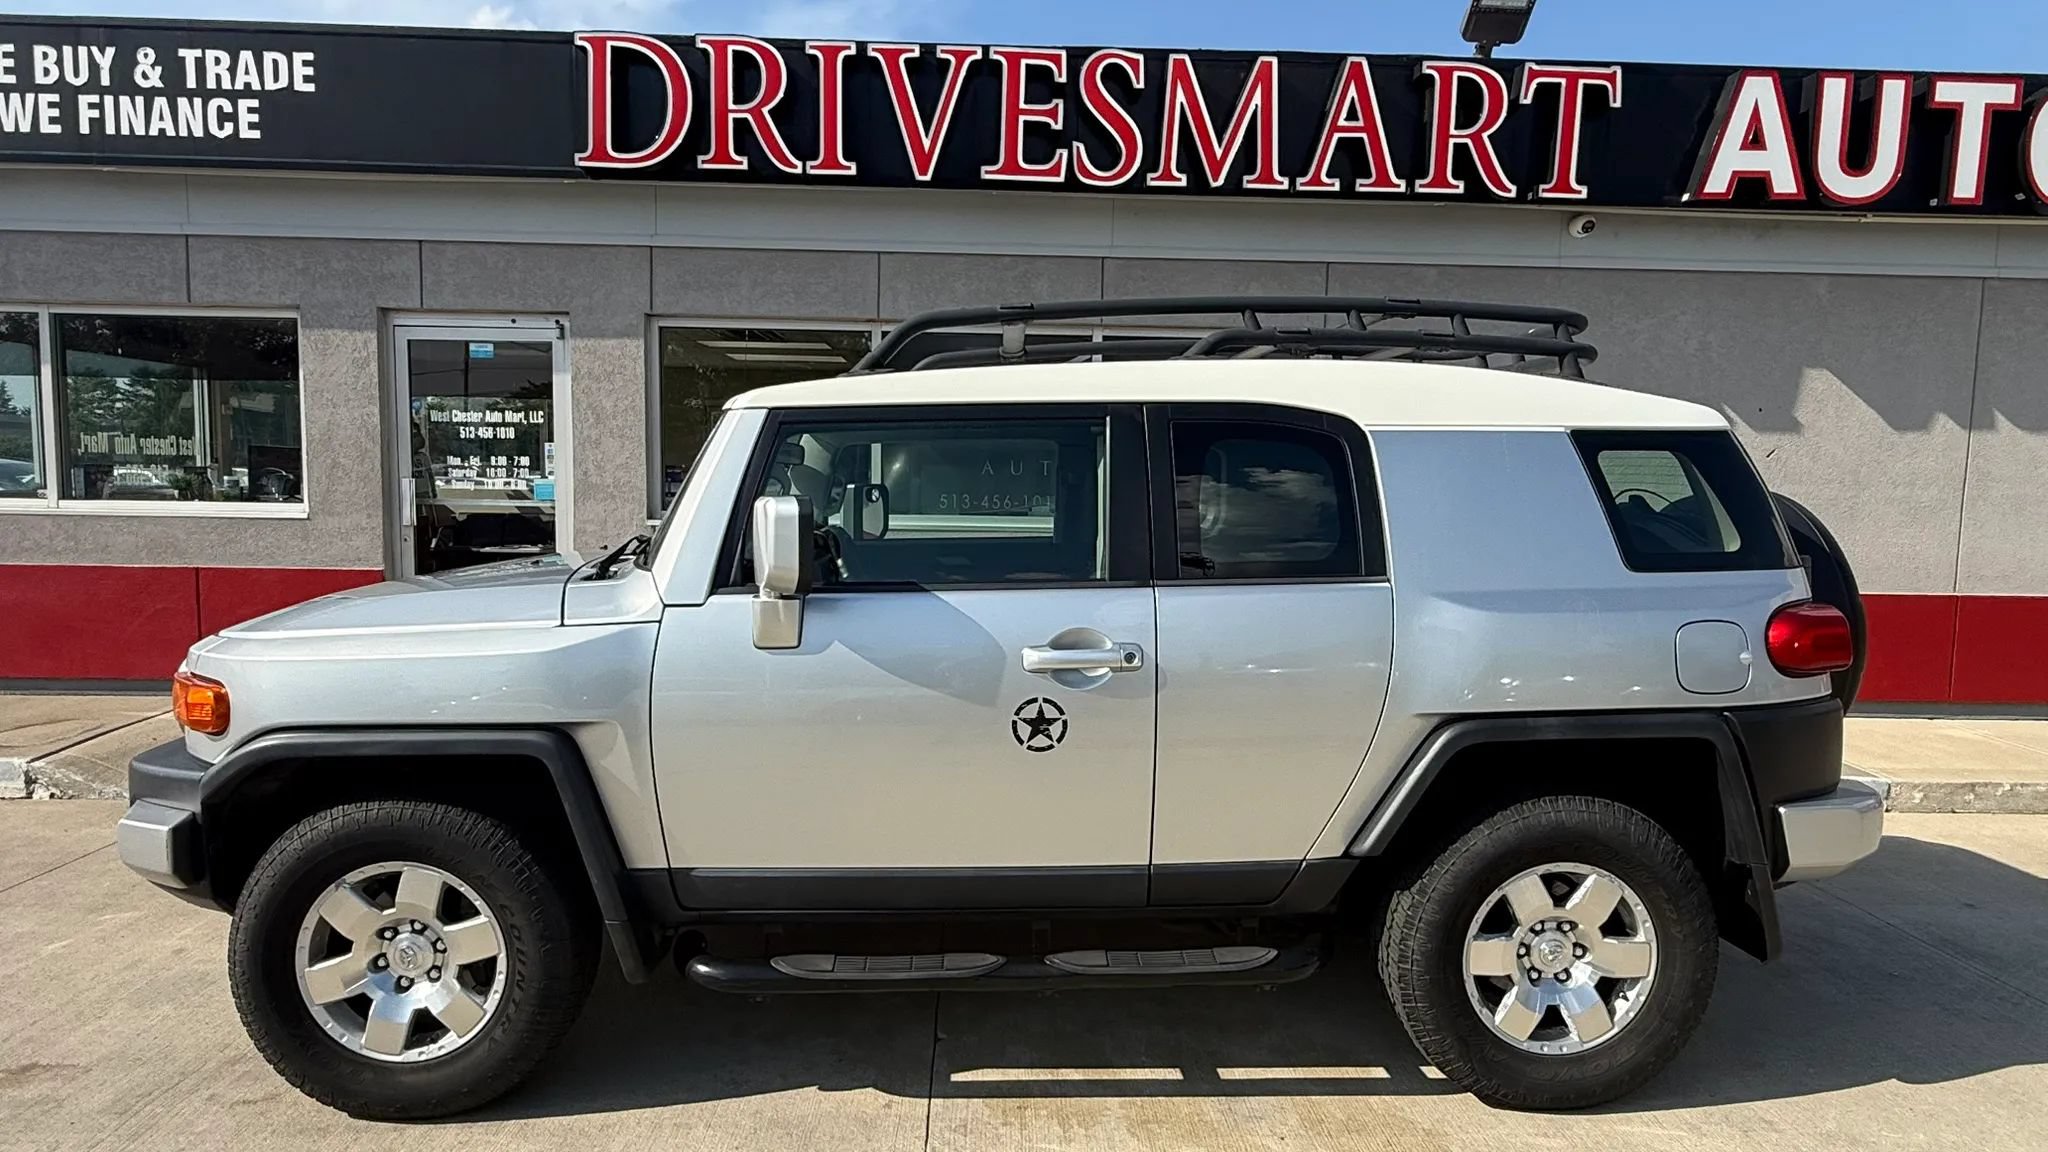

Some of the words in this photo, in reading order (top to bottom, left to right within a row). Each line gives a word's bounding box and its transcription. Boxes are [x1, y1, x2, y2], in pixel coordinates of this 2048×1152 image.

[32, 44, 116, 87] BUY
[133, 46, 165, 88] &
[177, 48, 316, 92] TRADE
[0, 92, 62, 134] WE
[77, 94, 262, 139] FINANCE
[574, 31, 1622, 199] DRIVESMART
[1698, 70, 2048, 206] AUT
[430, 409, 450, 423] West
[452, 409, 483, 423] Chester
[485, 409, 503, 423] Auto
[505, 409, 527, 425] Mart,
[529, 410, 545, 424] LLC
